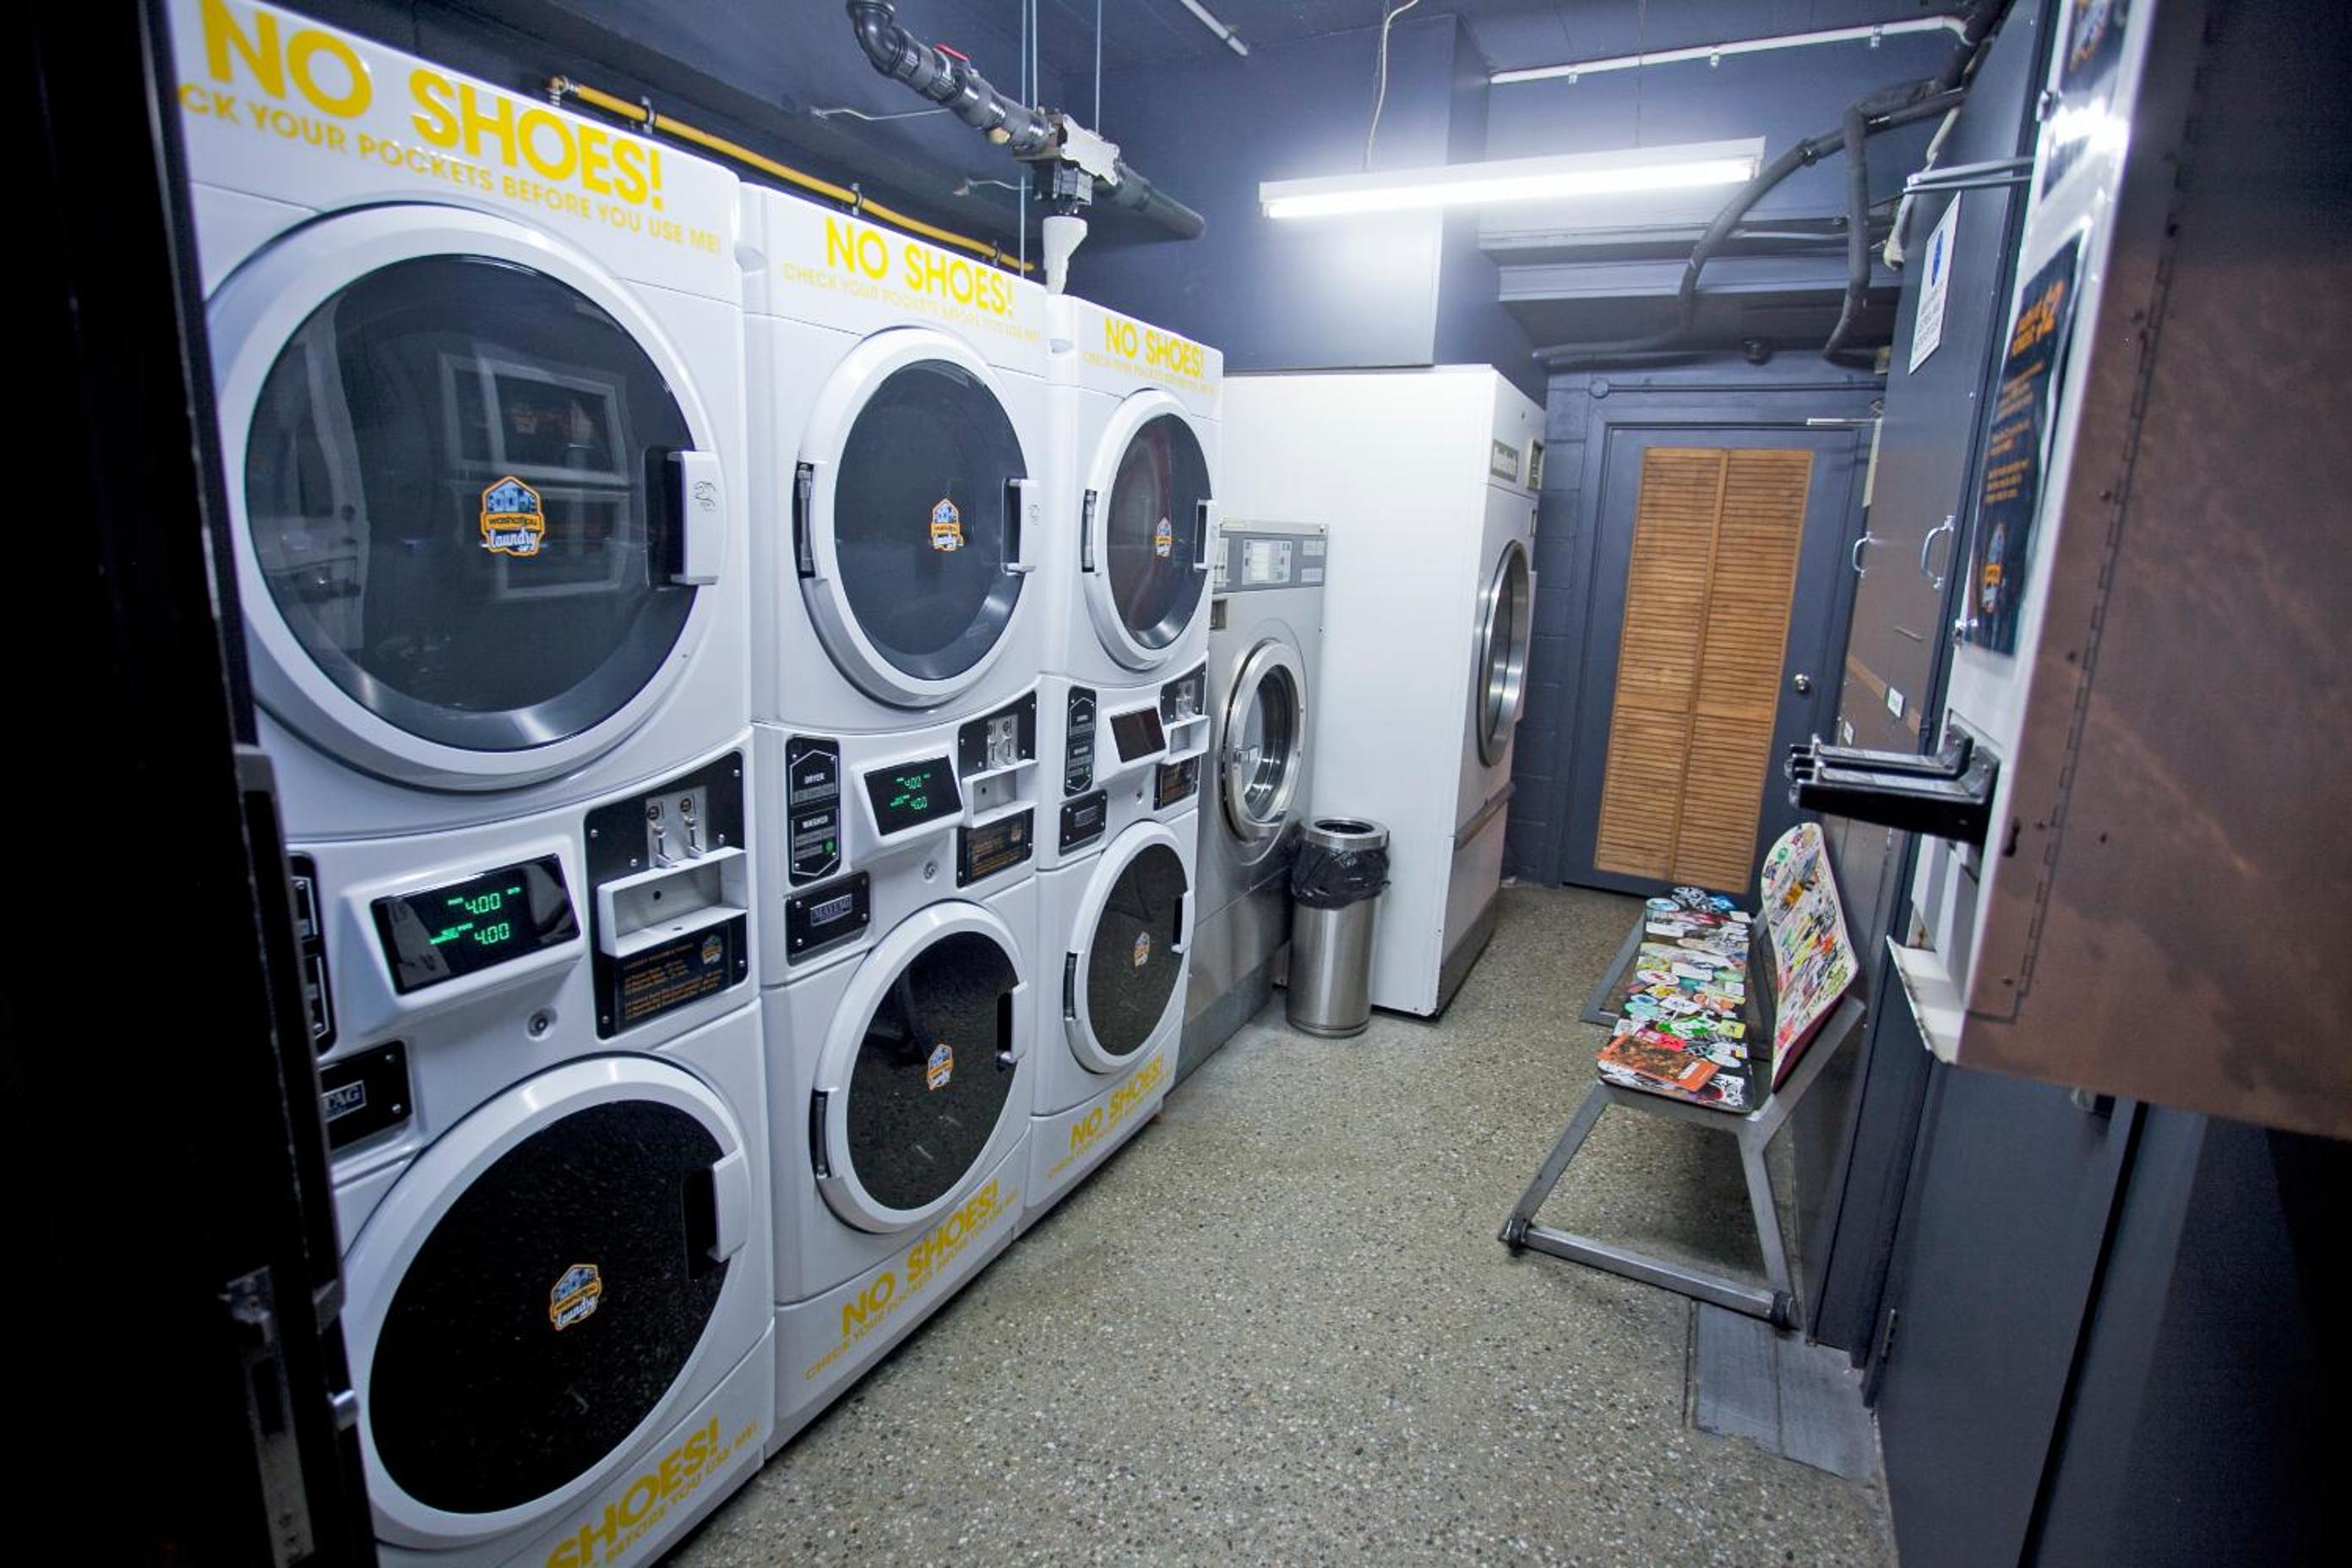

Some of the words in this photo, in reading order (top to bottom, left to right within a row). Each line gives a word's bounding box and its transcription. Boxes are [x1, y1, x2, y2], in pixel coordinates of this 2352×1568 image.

[200, 0, 372, 118] NO
[409, 67, 663, 210] SHOES!
[248, 100, 346, 153] YOUR
[357, 132, 493, 192] POCKETS
[502, 175, 591, 218] BEFORE
[596, 201, 642, 234] YOU
[648, 216, 683, 245] USE
[825, 216, 889, 280] NO
[903, 242, 1014, 318] SHOES!
[1104, 316, 1139, 359] NO
[1144, 328, 1204, 378] SHOES!
[465, 892, 502, 915] 4.00
[474, 923, 510, 945] 4.00
[1070, 1106, 1103, 1151] NO
[841, 1271, 896, 1337] NO
[906, 1178, 999, 1282] SHOES!
[546, 1413, 720, 1568] SHOES!
